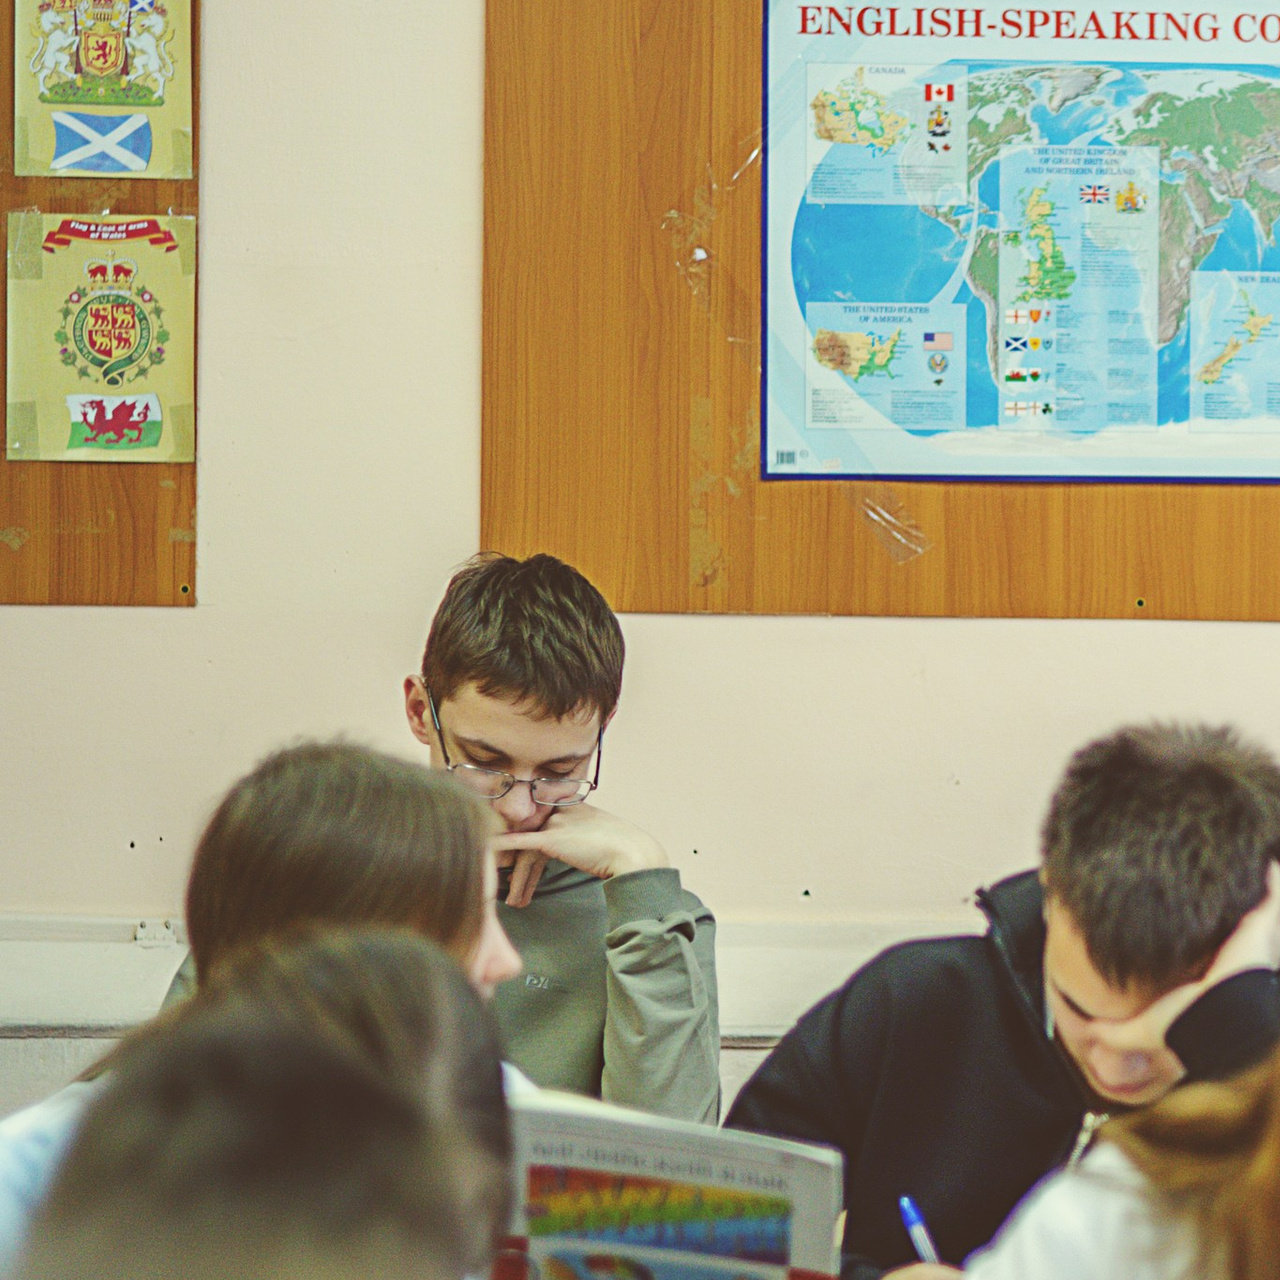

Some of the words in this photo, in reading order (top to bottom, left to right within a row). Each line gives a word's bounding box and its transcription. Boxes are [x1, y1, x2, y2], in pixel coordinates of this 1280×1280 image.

[796, 4, 1221, 43] ENGLISH-SPEAKING
[868, 66, 906, 75] CANADA
[1032, 147, 1049, 156] THE
[1051, 147, 1085, 156] UNITED
[1052, 157, 1081, 165] GREAT
[101, 232, 127, 240] Wales
[1238, 276, 1258, 284] NEW
[842, 305, 861, 314] THE
[861, 305, 897, 315] UNITED
[898, 306, 930, 315] STATES
[859, 315, 870, 324] OF
[872, 315, 914, 324] AMERICA
